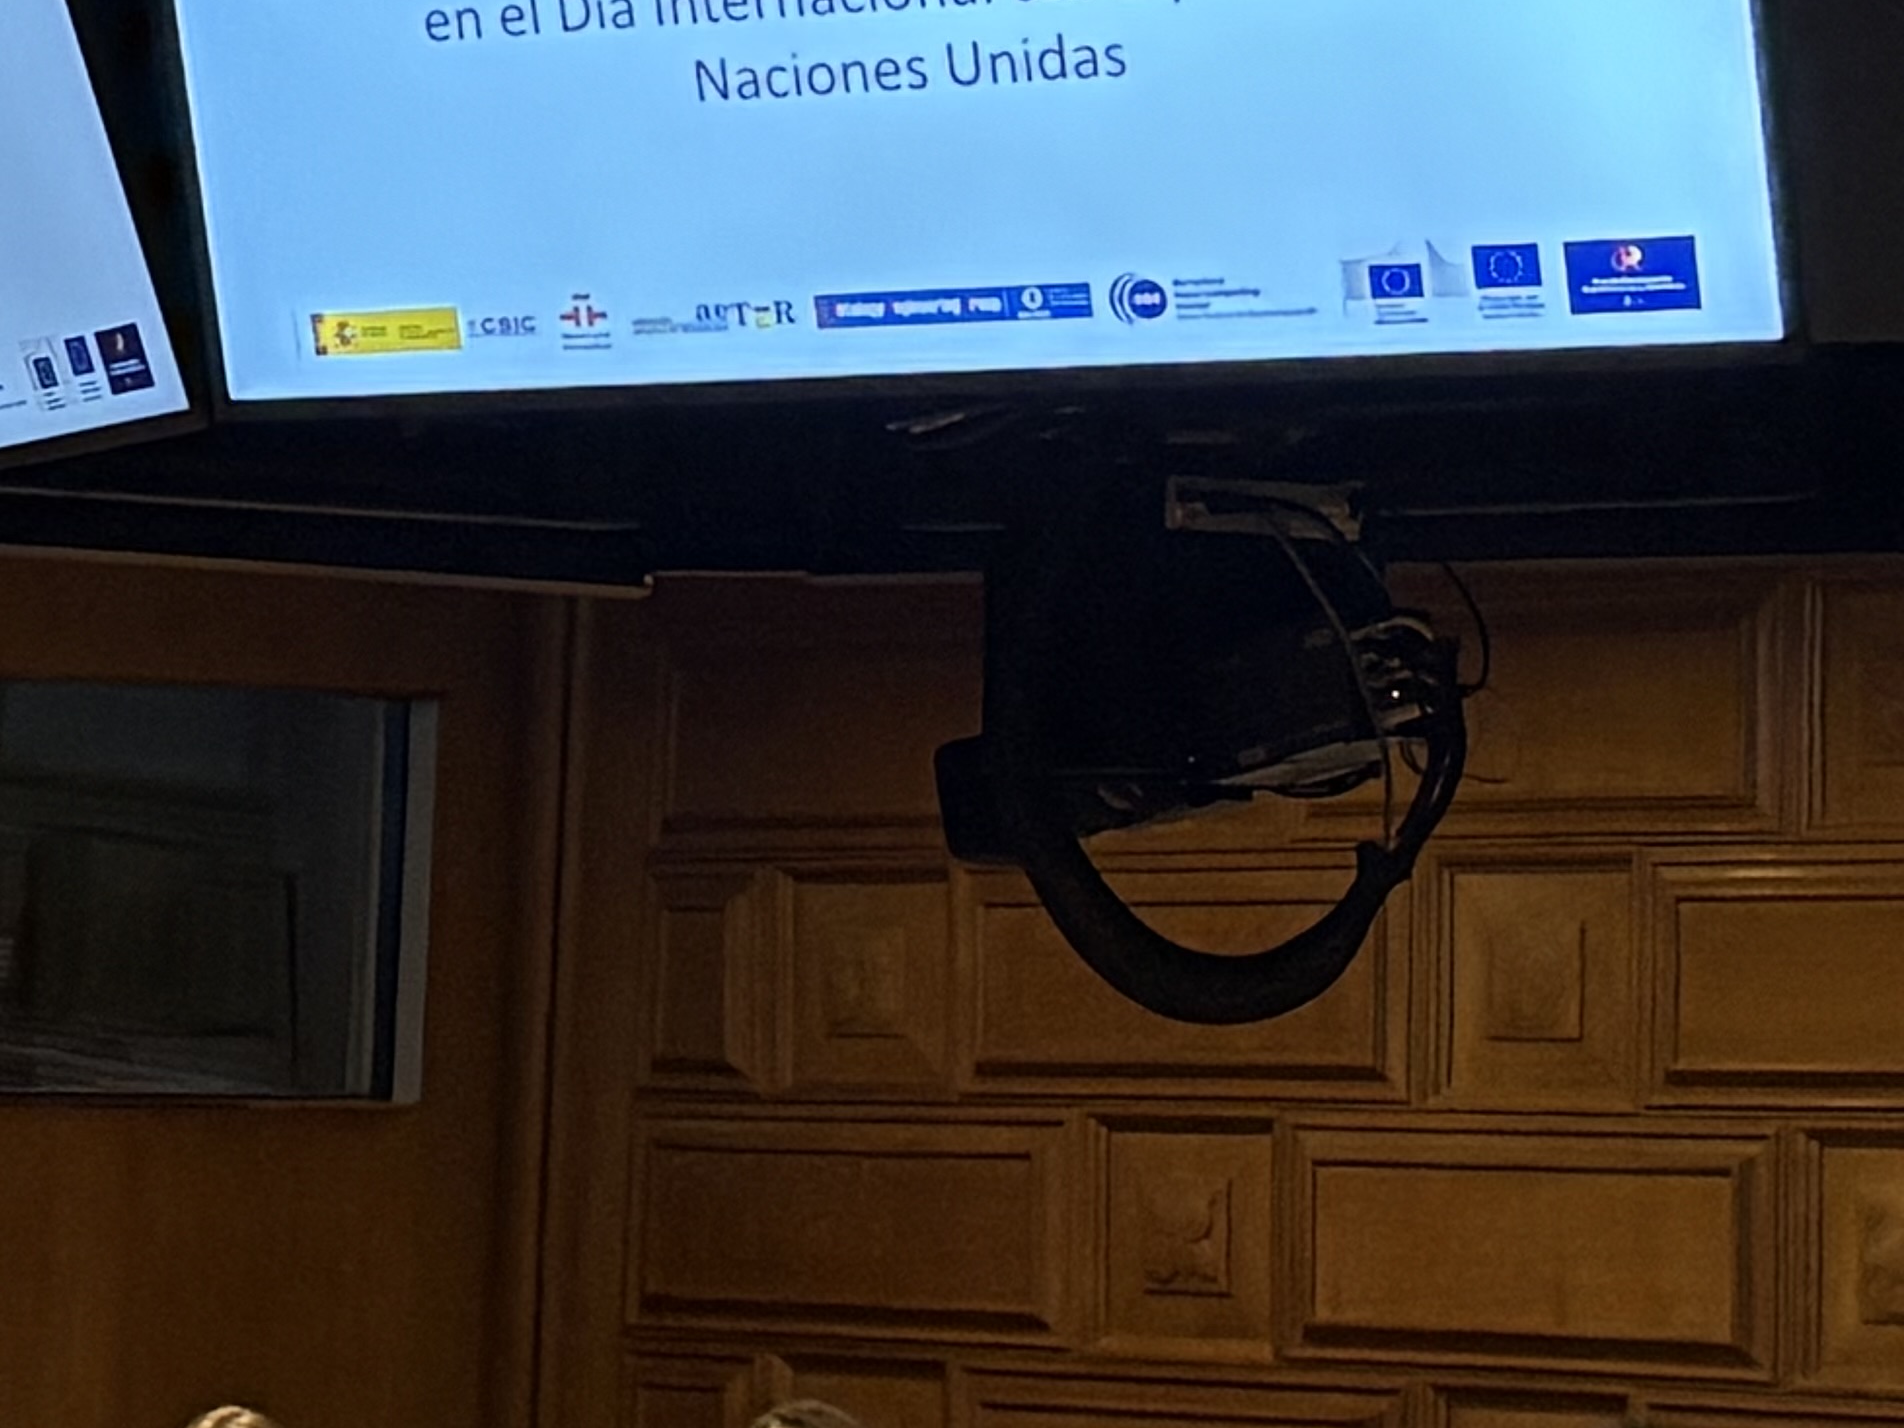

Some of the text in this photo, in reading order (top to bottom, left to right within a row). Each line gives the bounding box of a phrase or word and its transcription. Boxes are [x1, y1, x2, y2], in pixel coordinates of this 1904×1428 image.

[425, 7, 482, 41] en
[695, 33, 1127, 102] Naciones Unidas
